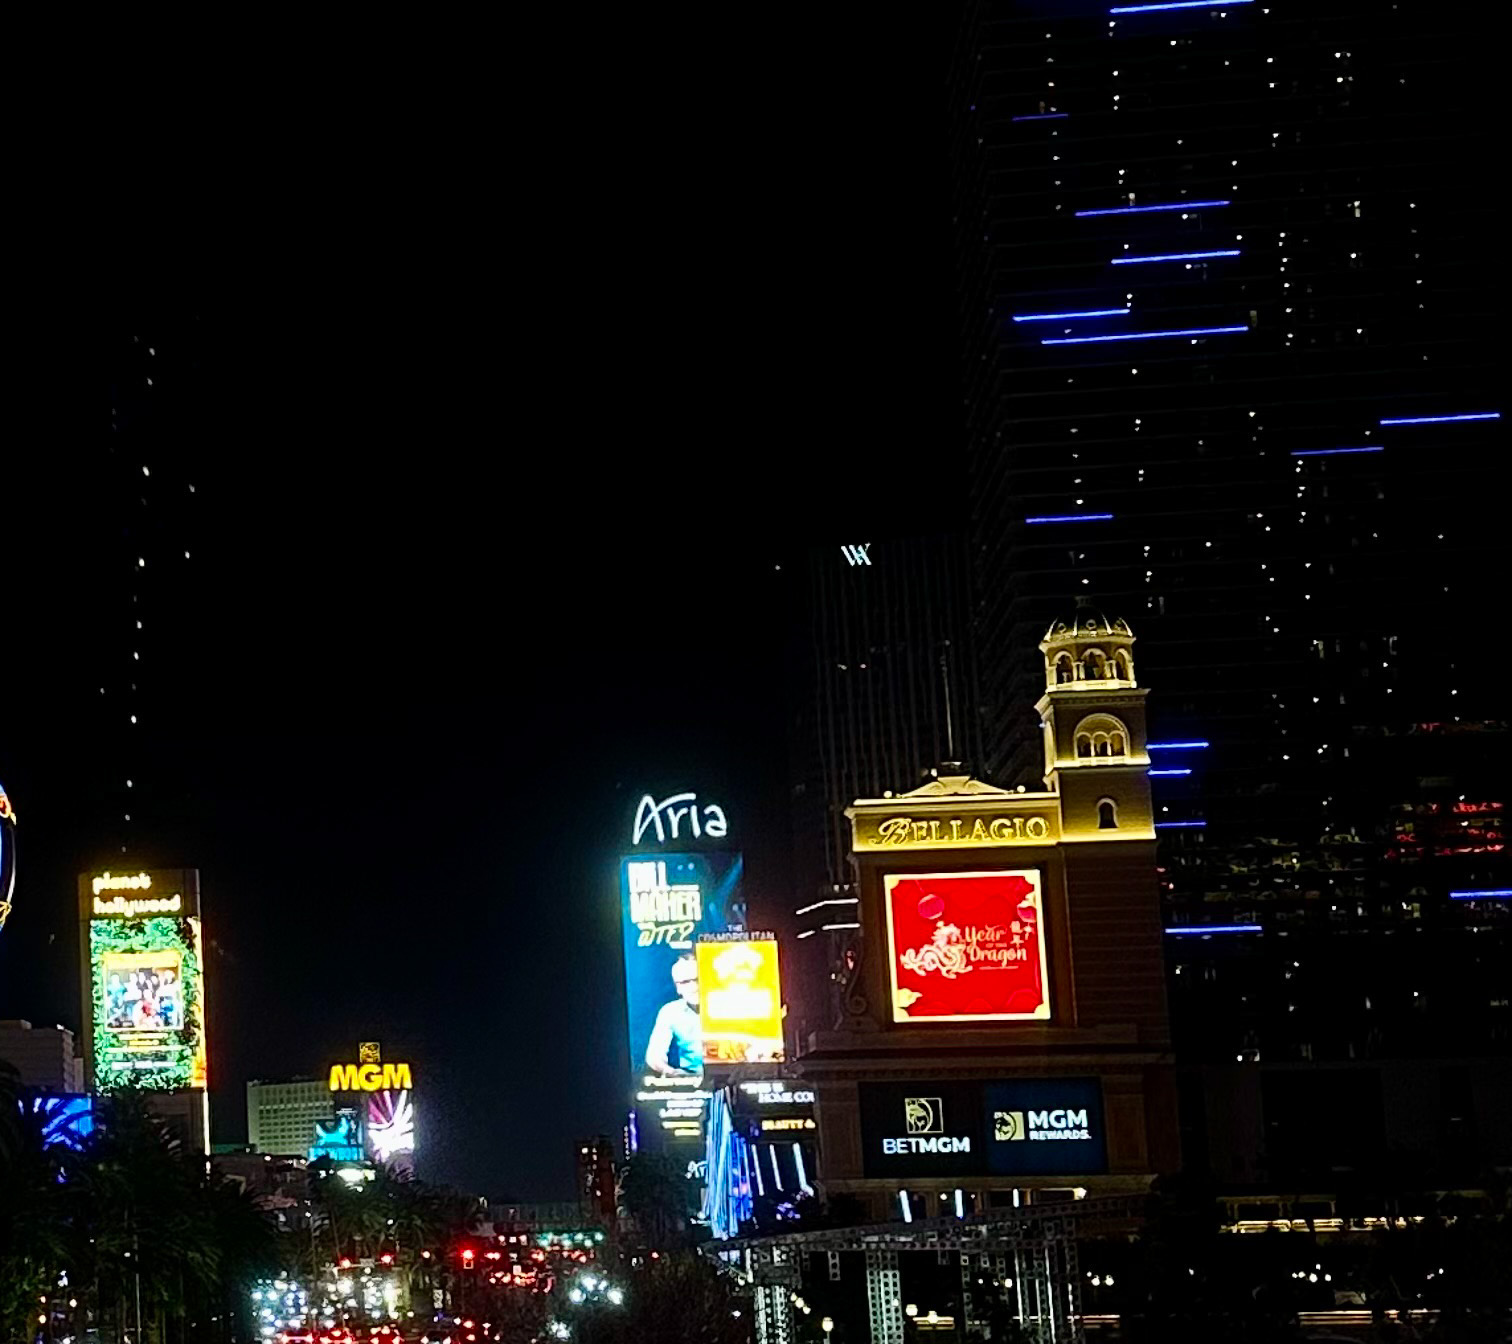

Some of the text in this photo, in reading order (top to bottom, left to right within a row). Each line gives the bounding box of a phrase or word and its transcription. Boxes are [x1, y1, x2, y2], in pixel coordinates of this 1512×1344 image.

[632, 792, 728, 845] Aria
[869, 816, 1050, 845] BELLAGIO
[92, 872, 152, 895] planet
[93, 894, 181, 917] hollywood
[963, 924, 1008, 943] Year
[966, 945, 1028, 968] Dragon
[329, 1063, 413, 1091] MGM
[1028, 1109, 1088, 1129] MGM
[883, 1136, 971, 1154] BETMGM
